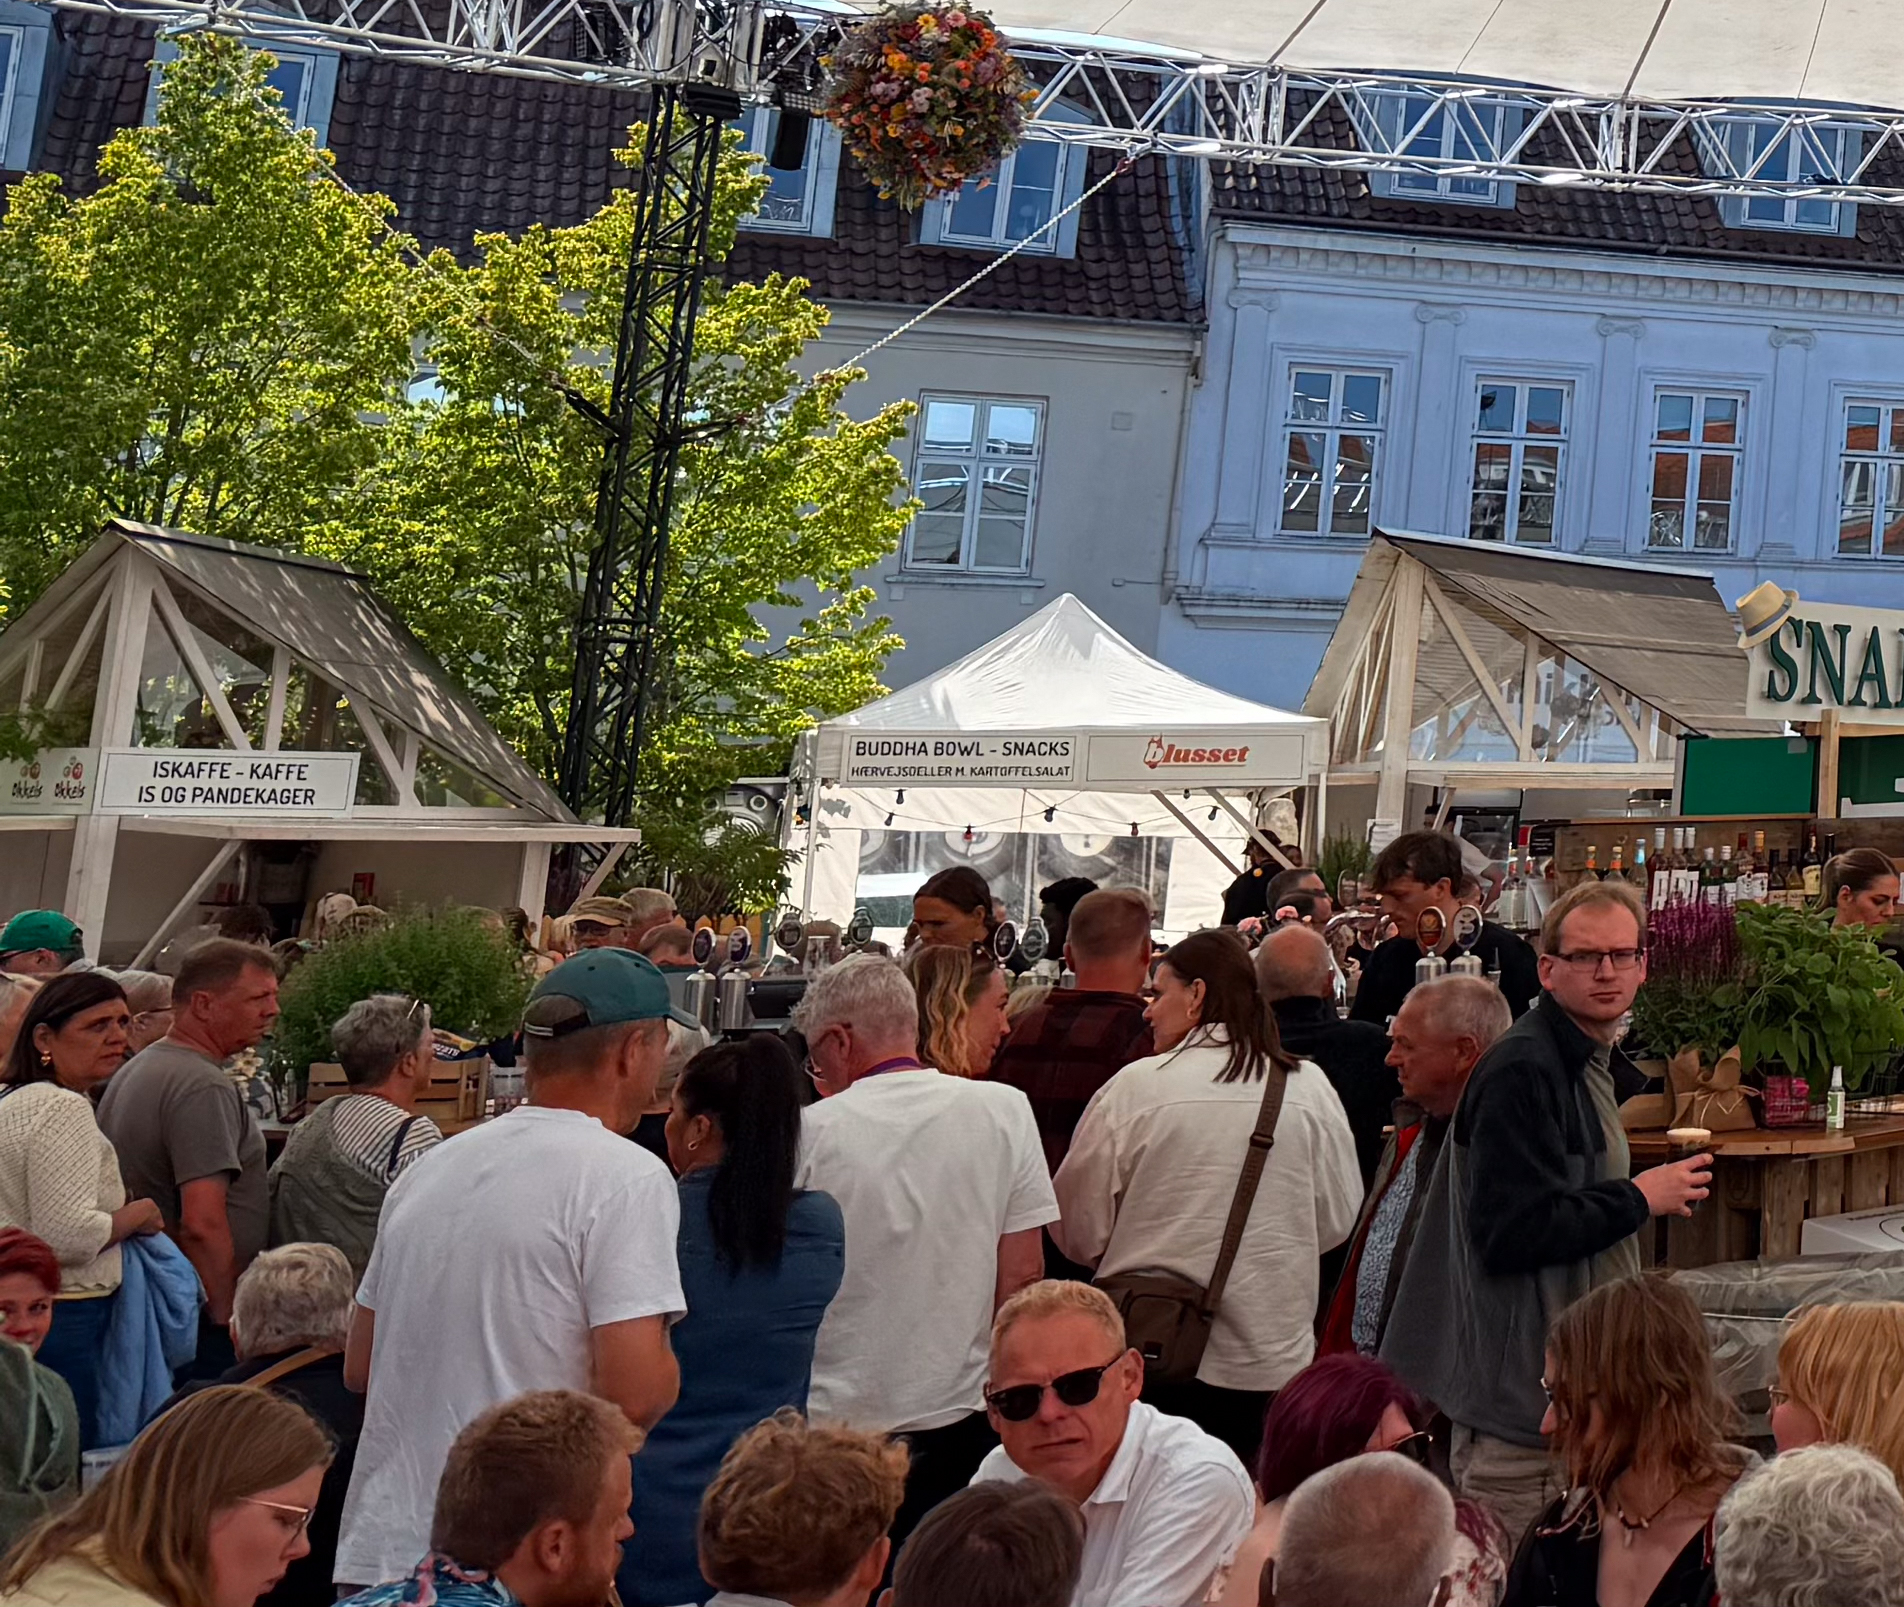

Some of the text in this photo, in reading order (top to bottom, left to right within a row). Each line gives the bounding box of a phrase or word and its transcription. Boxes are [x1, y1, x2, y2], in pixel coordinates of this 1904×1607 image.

[855, 741, 928, 756] BUDDHA
[934, 741, 985, 756] BOWL
[1002, 741, 1070, 756] SNACKS
[153, 761, 232, 780] ISKAFFE
[249, 763, 309, 781] KAFFE
[970, 766, 1070, 777] KARTOFFELSALAT
[138, 786, 316, 806] IS OG PANDEKAGER
